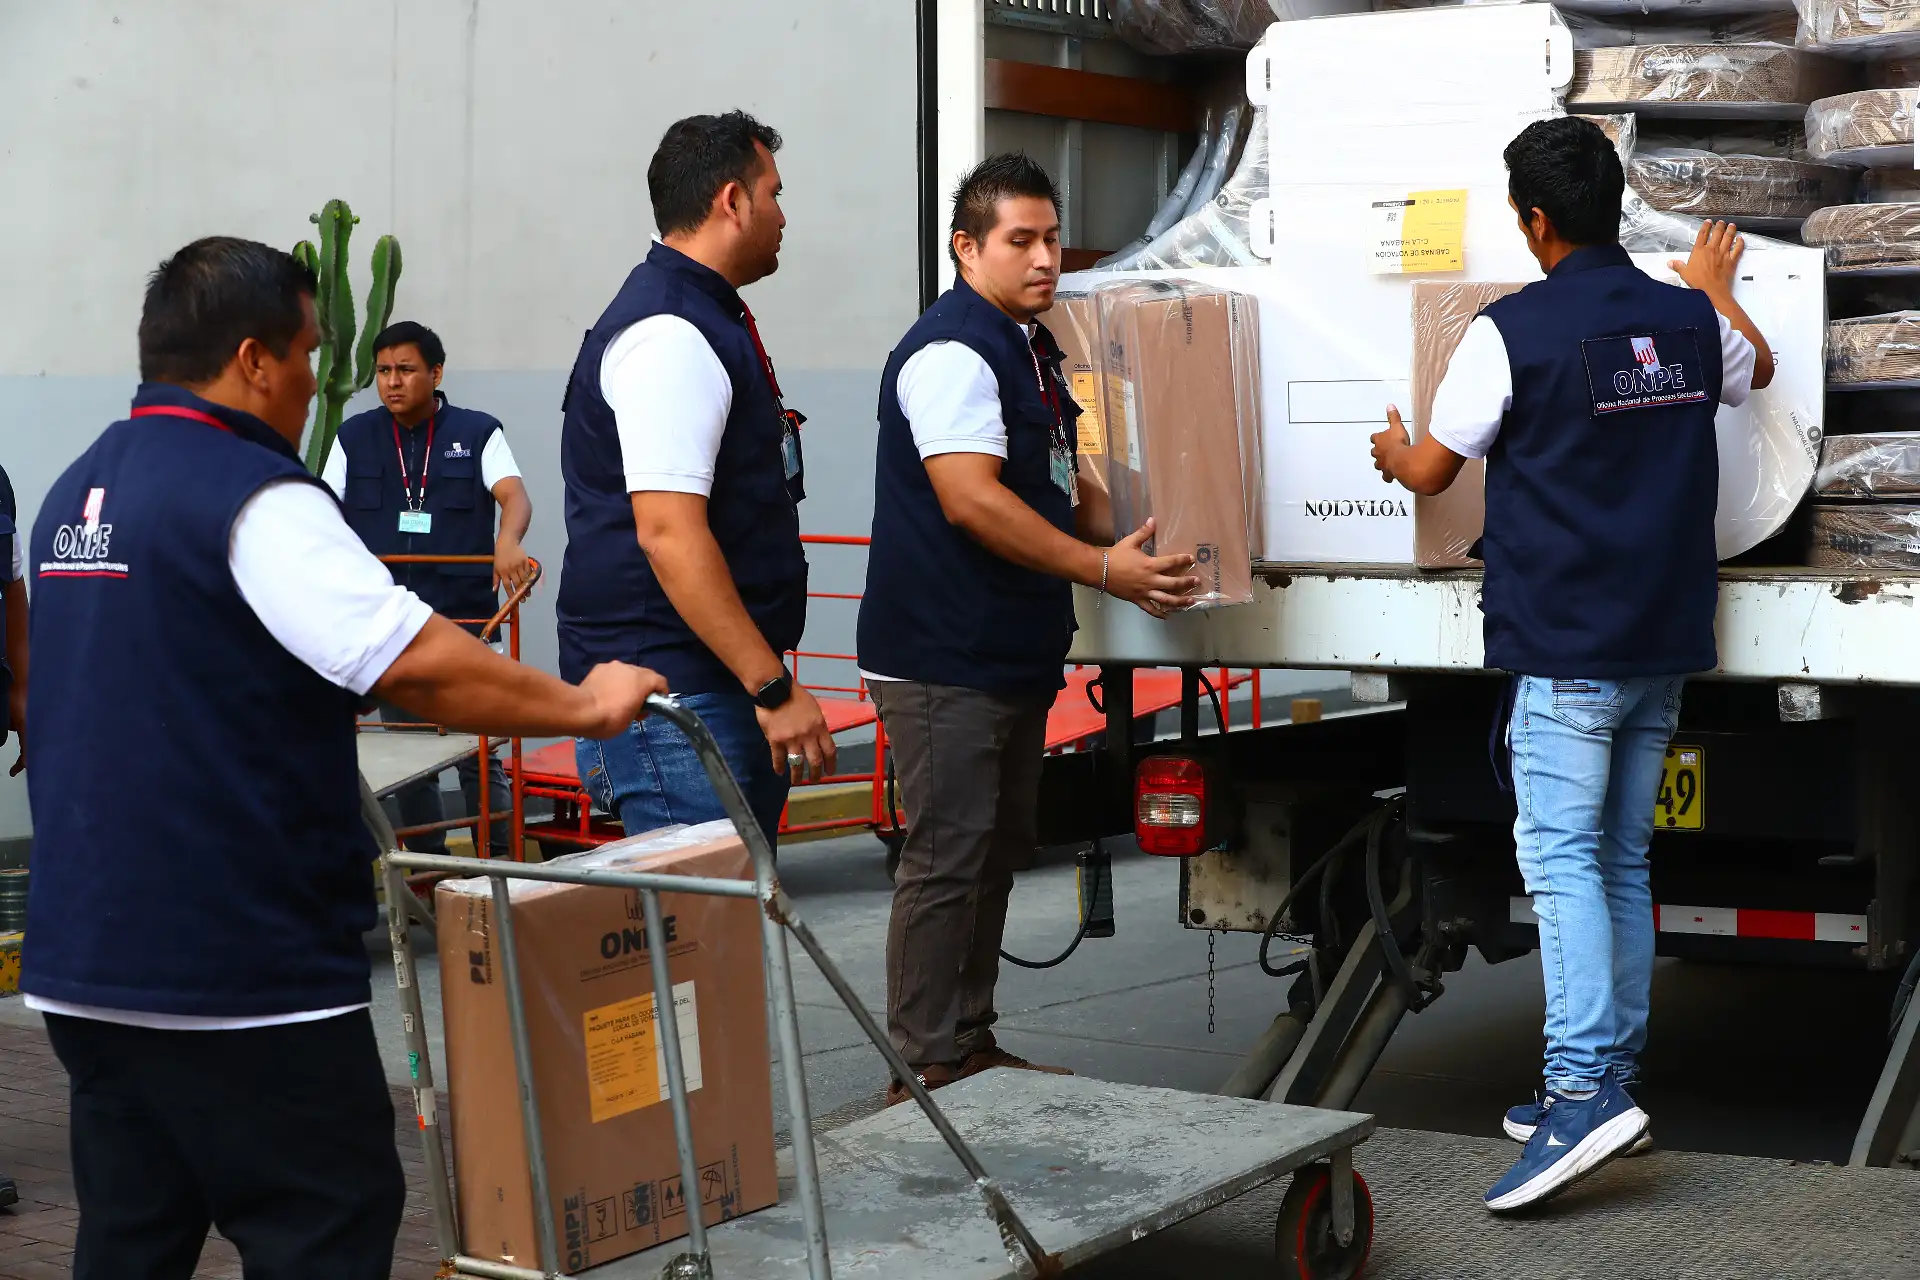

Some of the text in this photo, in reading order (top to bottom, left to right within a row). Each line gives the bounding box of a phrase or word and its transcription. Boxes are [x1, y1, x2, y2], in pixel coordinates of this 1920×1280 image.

[1420, 248, 1450, 256] CABINAS
[1613, 363, 1686, 396] ONPE
[1596, 400, 1617, 409] Oficina
[1617, 396, 1641, 407] Nacional
[1651, 393, 1676, 403] Procesos
[1676, 389, 1705, 399] Electorales
[444, 449, 471, 459] ONPE
[1304, 500, 1408, 522] VOTACIÓN
[53, 523, 112, 560] ONPE
[1655, 767, 1696, 815] 49
[679, 997, 690, 1006] DEL
[564, 1195, 583, 1272] ONPE
